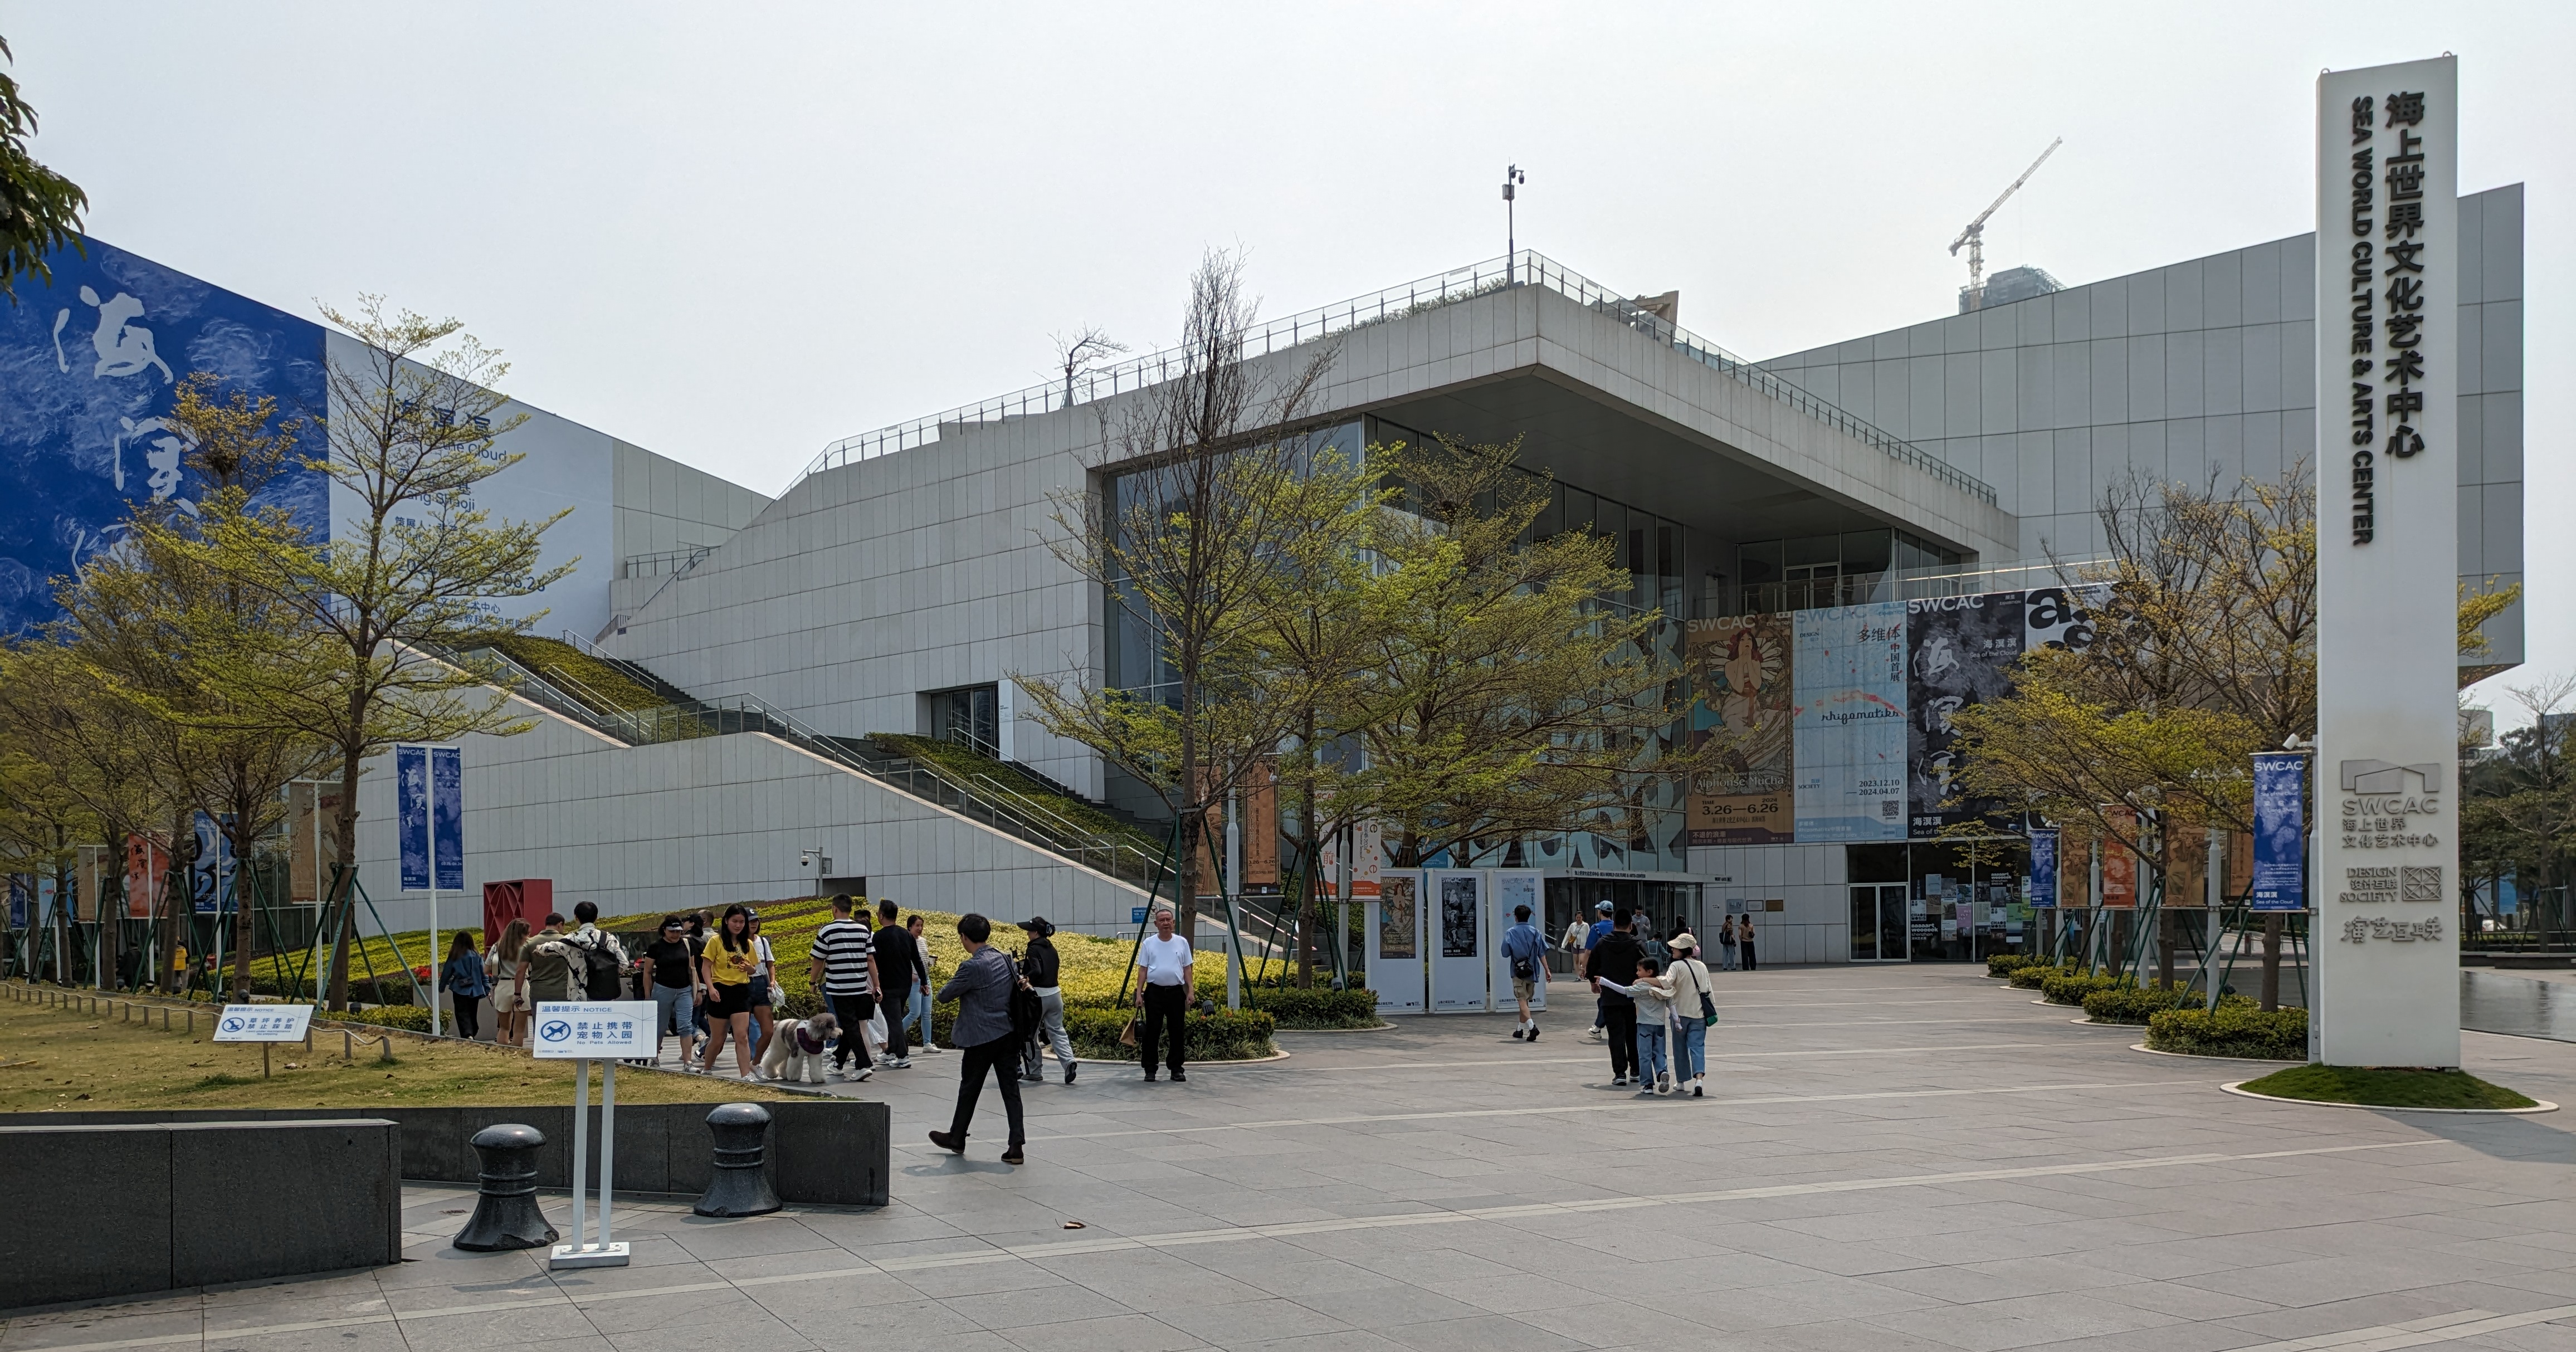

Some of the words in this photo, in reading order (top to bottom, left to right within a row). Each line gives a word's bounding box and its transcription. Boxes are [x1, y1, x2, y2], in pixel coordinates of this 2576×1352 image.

[2352, 95, 2373, 147] SEA
[2352, 147, 2373, 237] WORLD
[2385, 91, 2425, 458] 海上世界文化艺术中心
[2352, 241, 2373, 354] CULTURE
[2352, 360, 2373, 378] &
[2352, 382, 2373, 445] ARTS
[2352, 451, 2374, 546] CENTER
[1908, 595, 1984, 614] SWCAC
[1795, 606, 1867, 624] SWCAC
[1687, 614, 1756, 633] SWCAC
[1857, 627, 1901, 643] 多维体
[1890, 643, 1900, 682] 中国首展
[2254, 760, 2304, 772] SWCAC
[1696, 778, 1746, 790] Alphonse
[1749, 775, 1784, 785] Mucha
[1858, 779, 1900, 788] 2023.12.10
[1858, 788, 1900, 796] 2024.04.07
[2342, 797, 2440, 816] SWCAC
[1913, 816, 1942, 827] 海溟溟
[2343, 818, 2406, 832] 海上世界
[2343, 833, 2439, 849] 文化艺术中心
[2346, 867, 2398, 878] DESIGN
[2350, 878, 2398, 891] 设计互联
[2340, 891, 2398, 902] SOCIETY
[577, 1022, 633, 1030] 禁止携带
[577, 1031, 632, 1039] 宠物入园
